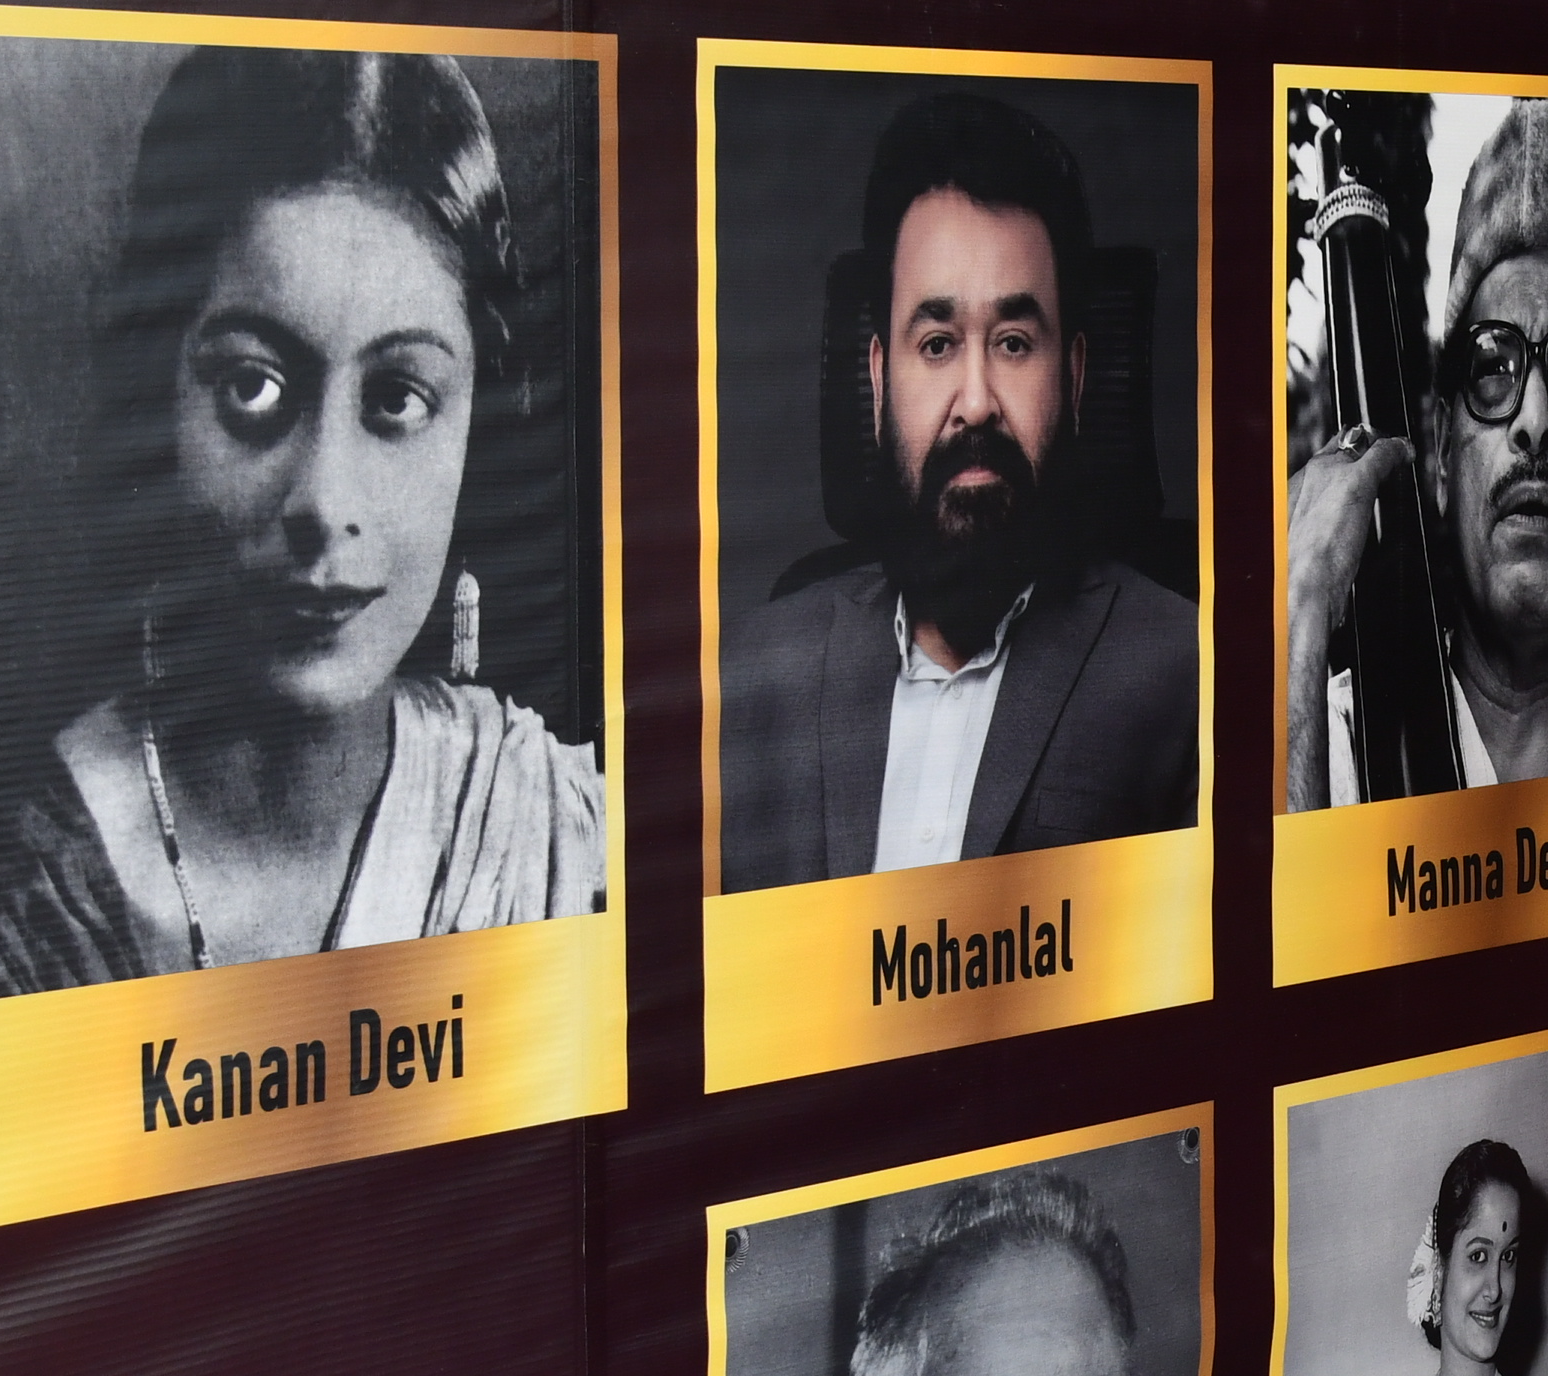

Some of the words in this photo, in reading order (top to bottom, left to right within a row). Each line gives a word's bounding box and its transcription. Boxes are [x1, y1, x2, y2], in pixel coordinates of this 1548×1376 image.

[1388, 845, 1507, 916] Manna
[873, 899, 1073, 1005] Mohanlal
[142, 1039, 326, 1132] Kanan
[349, 994, 463, 1096] Devi
